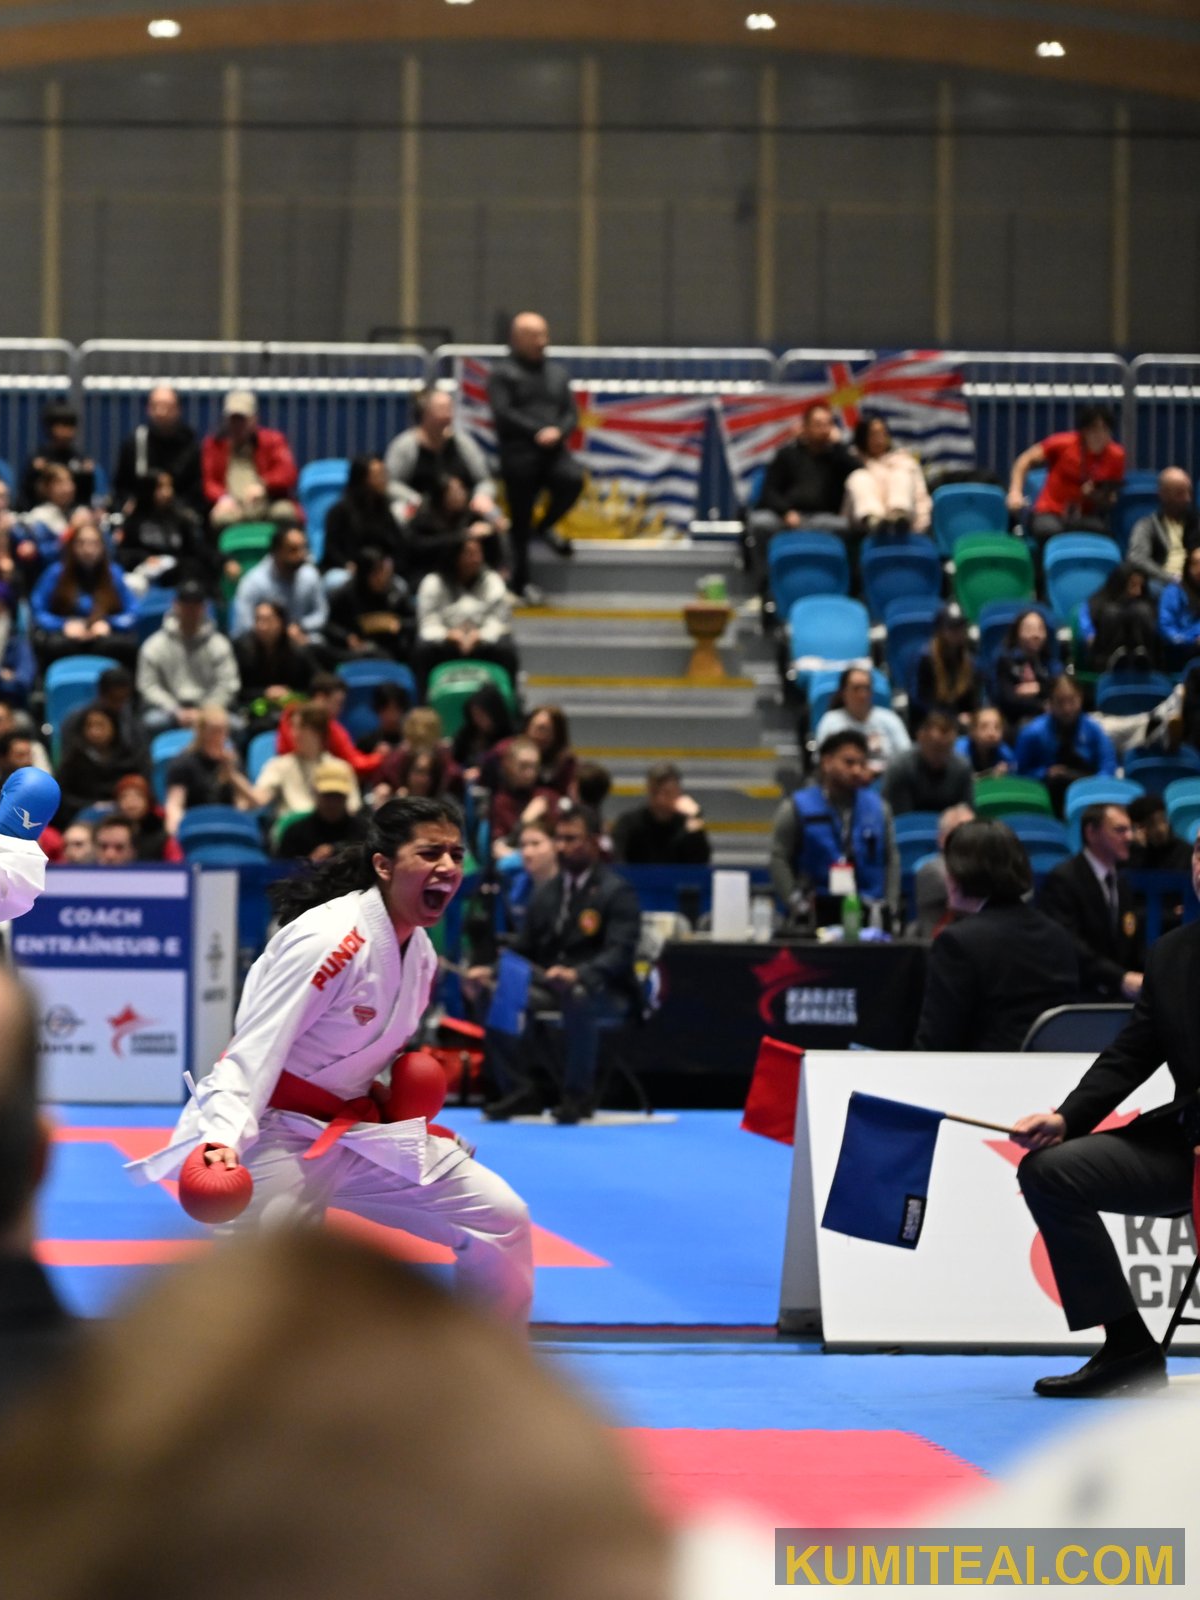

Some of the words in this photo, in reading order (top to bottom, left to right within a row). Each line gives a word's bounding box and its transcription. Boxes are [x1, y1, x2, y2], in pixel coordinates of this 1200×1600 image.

[59, 907, 142, 927] COACH
[786, 987, 857, 1005] KARATE
[785, 1006, 858, 1025] CANADA
